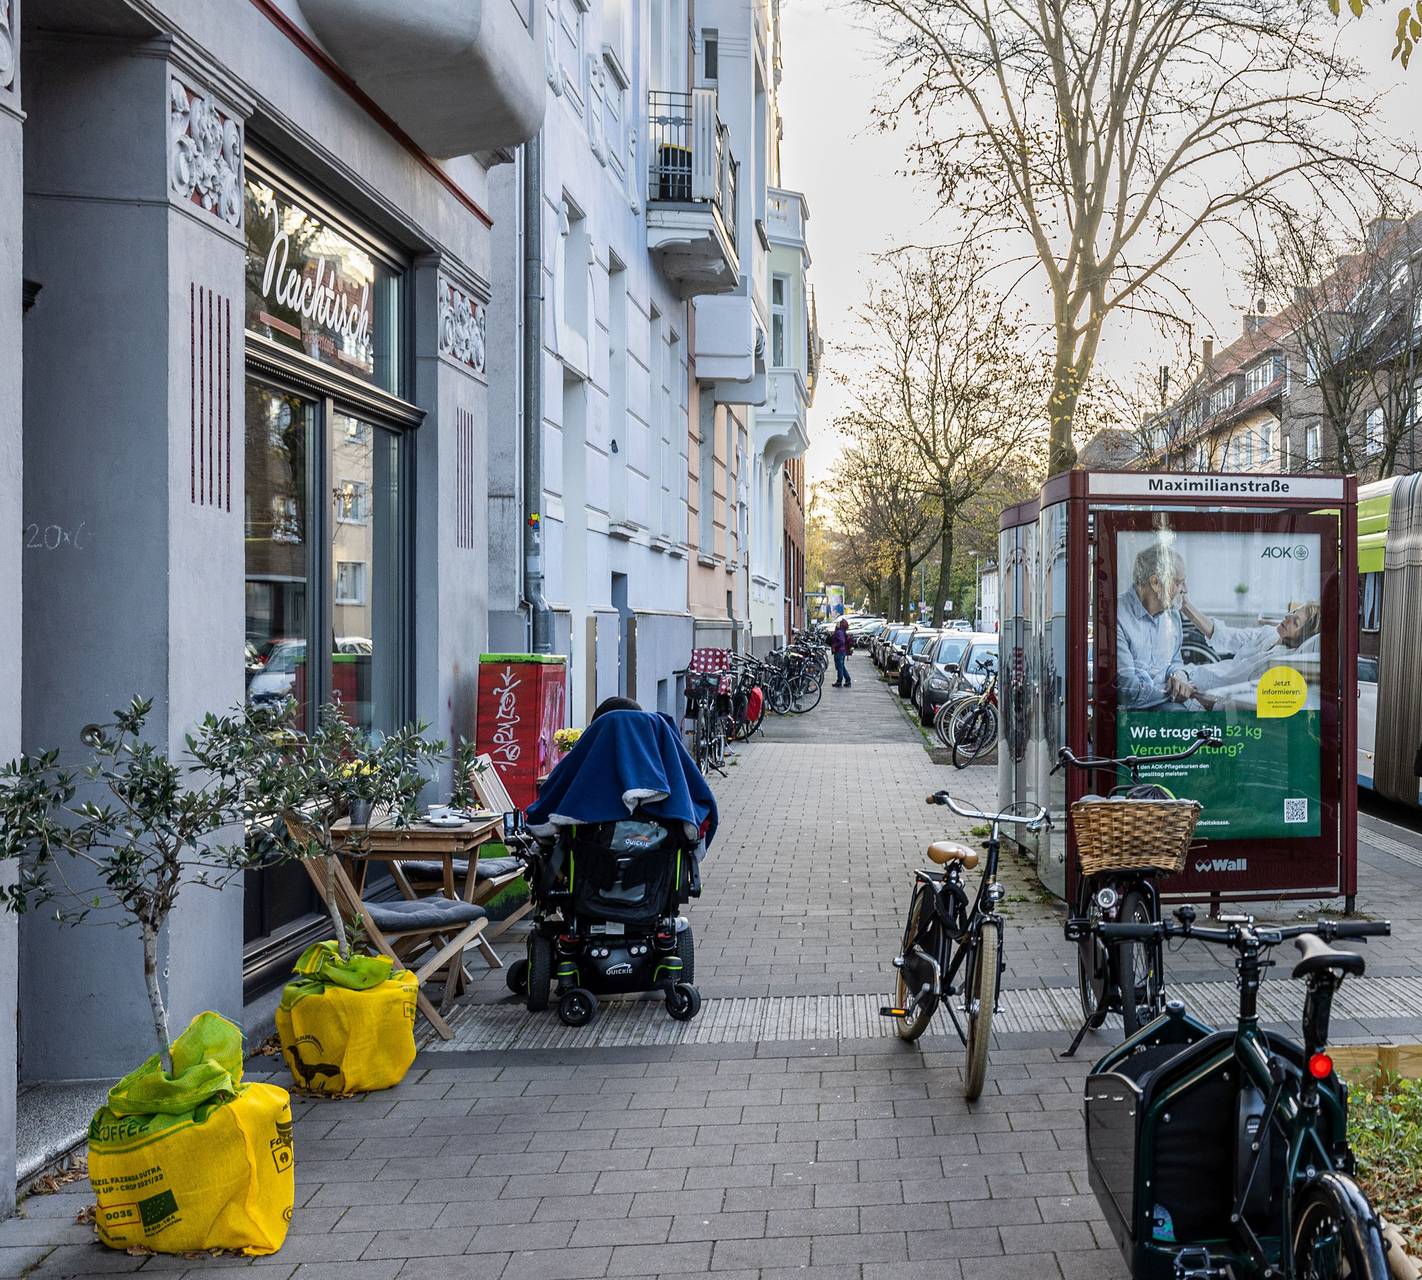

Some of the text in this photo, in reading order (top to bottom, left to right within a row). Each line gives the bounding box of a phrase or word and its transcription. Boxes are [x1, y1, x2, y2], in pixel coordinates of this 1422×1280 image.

[262, 199, 370, 346] Nachtisch
[1148, 478, 1290, 493] Maximilianstraße
[1261, 546, 1292, 558] AOK
[1130, 726, 1157, 739] Wie
[1160, 727, 1199, 740] trage
[1226, 725, 1241, 737] 52
[1245, 725, 1262, 739] kg
[624, 838, 650, 848] QUICKIE
[1212, 858, 1247, 871] Wall
[606, 967, 633, 975] QUICKIE
[105, 1209, 133, 1220] 0035
